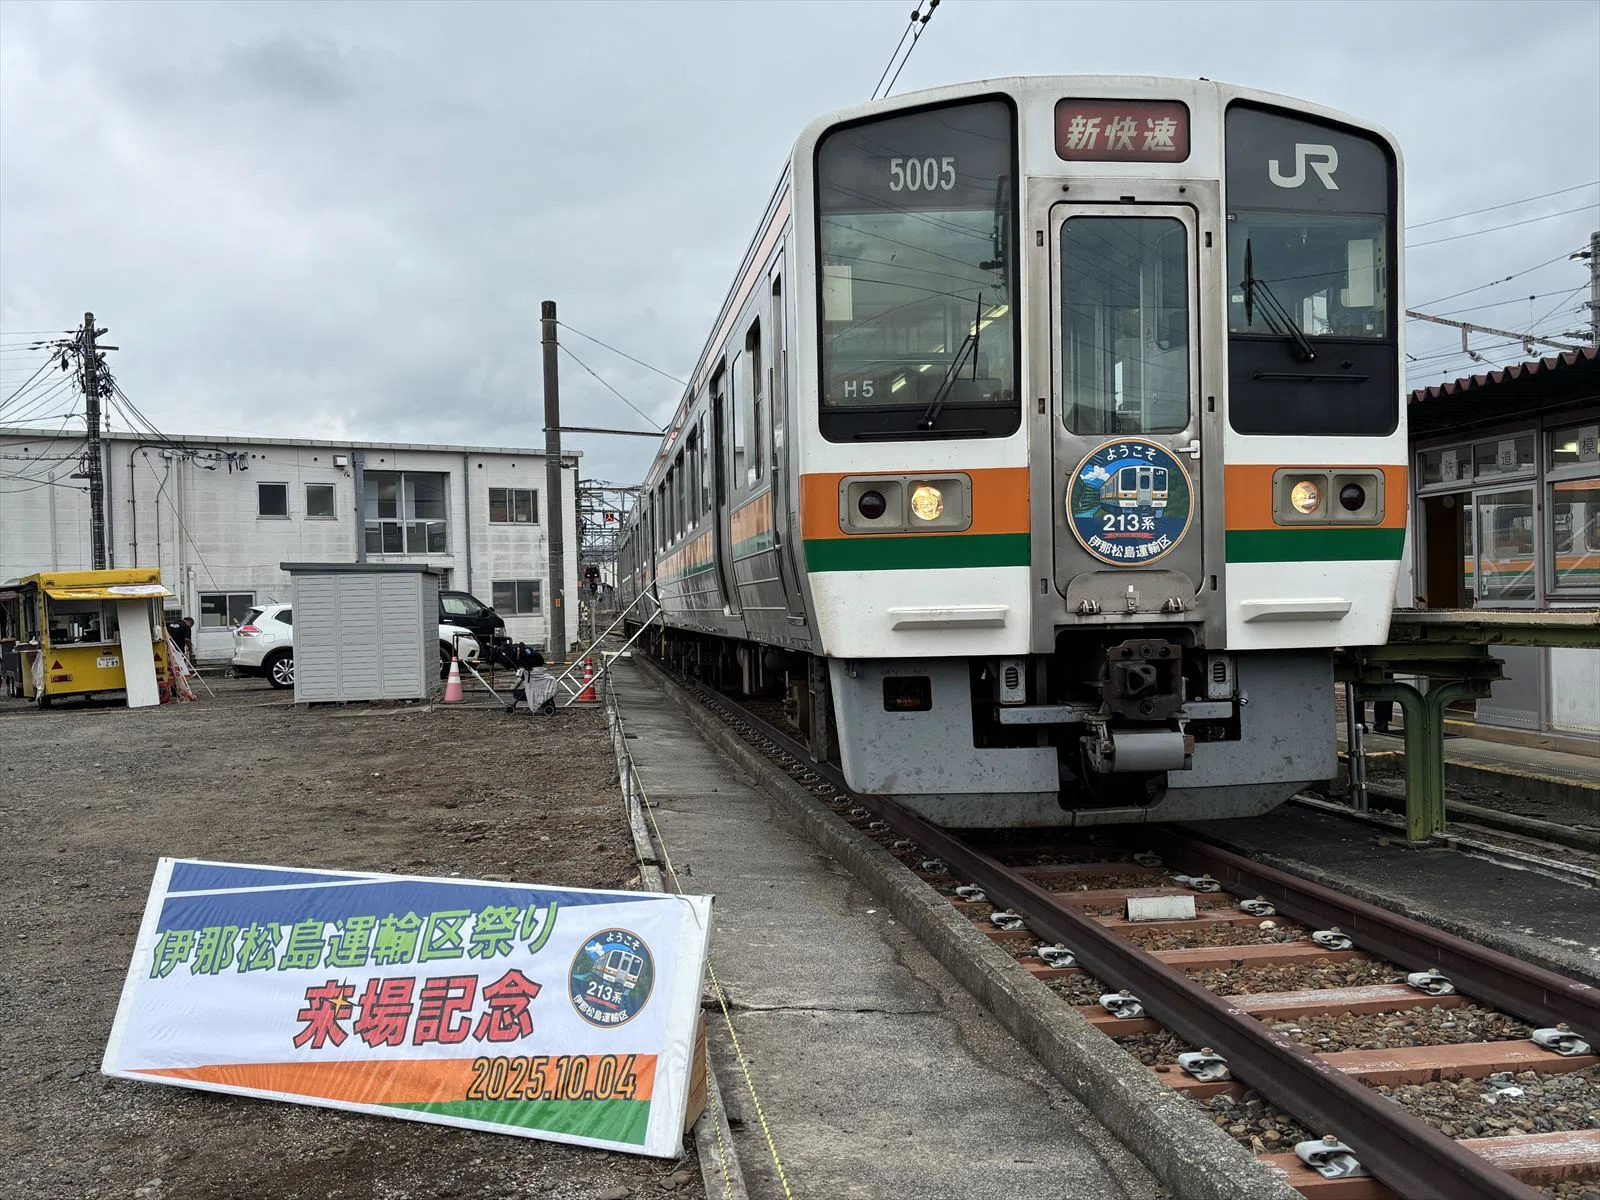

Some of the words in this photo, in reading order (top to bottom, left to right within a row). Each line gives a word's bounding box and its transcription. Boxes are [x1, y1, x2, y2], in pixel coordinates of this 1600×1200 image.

[1066, 115, 1178, 153] 新快速
[889, 157, 956, 192] 5005
[1268, 143, 1338, 190] JR
[1106, 445, 1156, 460] ようこそ
[1103, 514, 1155, 531] 213系
[1088, 534, 1172, 558] 伊那松島運輸区
[150, 901, 559, 979] 伊那松島運輸区祭り
[606, 932, 640, 950] ようこそ
[293, 968, 543, 1050] 来場記念
[586, 981, 623, 1003] 213系
[466, 1054, 638, 1101] 2025.10.04
